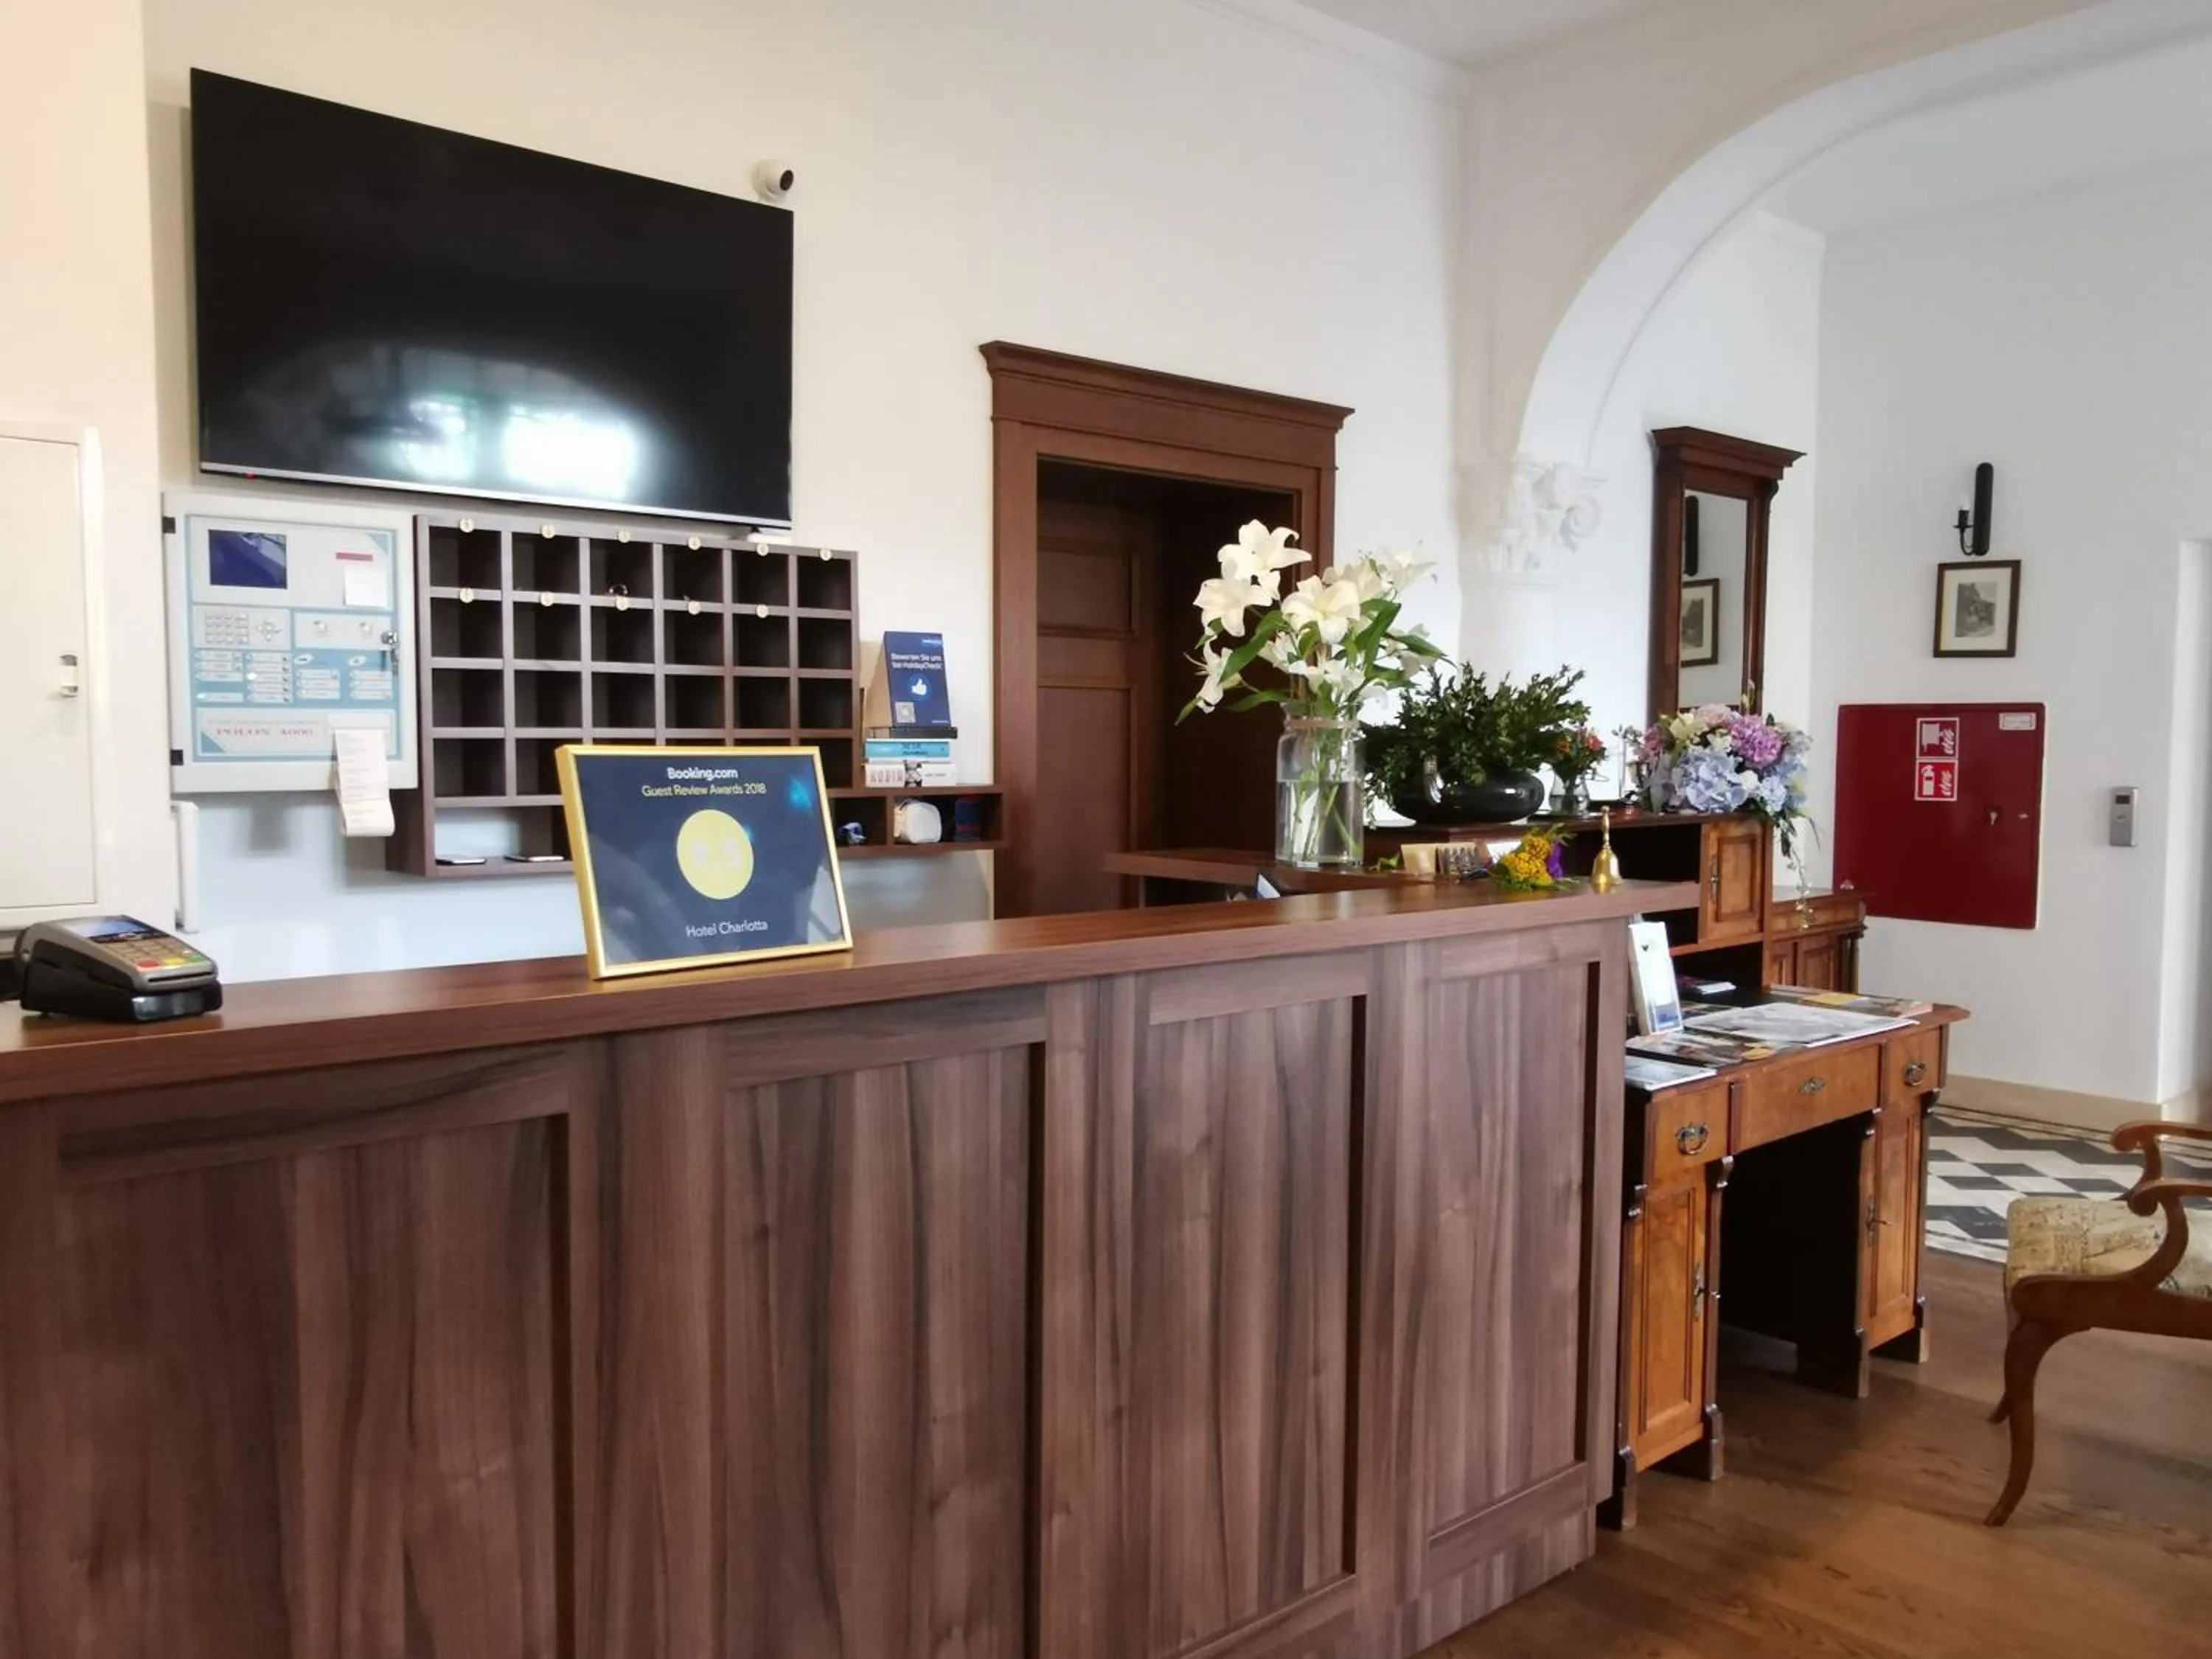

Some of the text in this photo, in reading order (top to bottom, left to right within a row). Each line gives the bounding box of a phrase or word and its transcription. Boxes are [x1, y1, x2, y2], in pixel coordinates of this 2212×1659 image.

[667, 767, 738, 781] Booking.com
[641, 782, 767, 796] Guest Review Awards 2018
[686, 920, 769, 937] Hotel Charlotta
